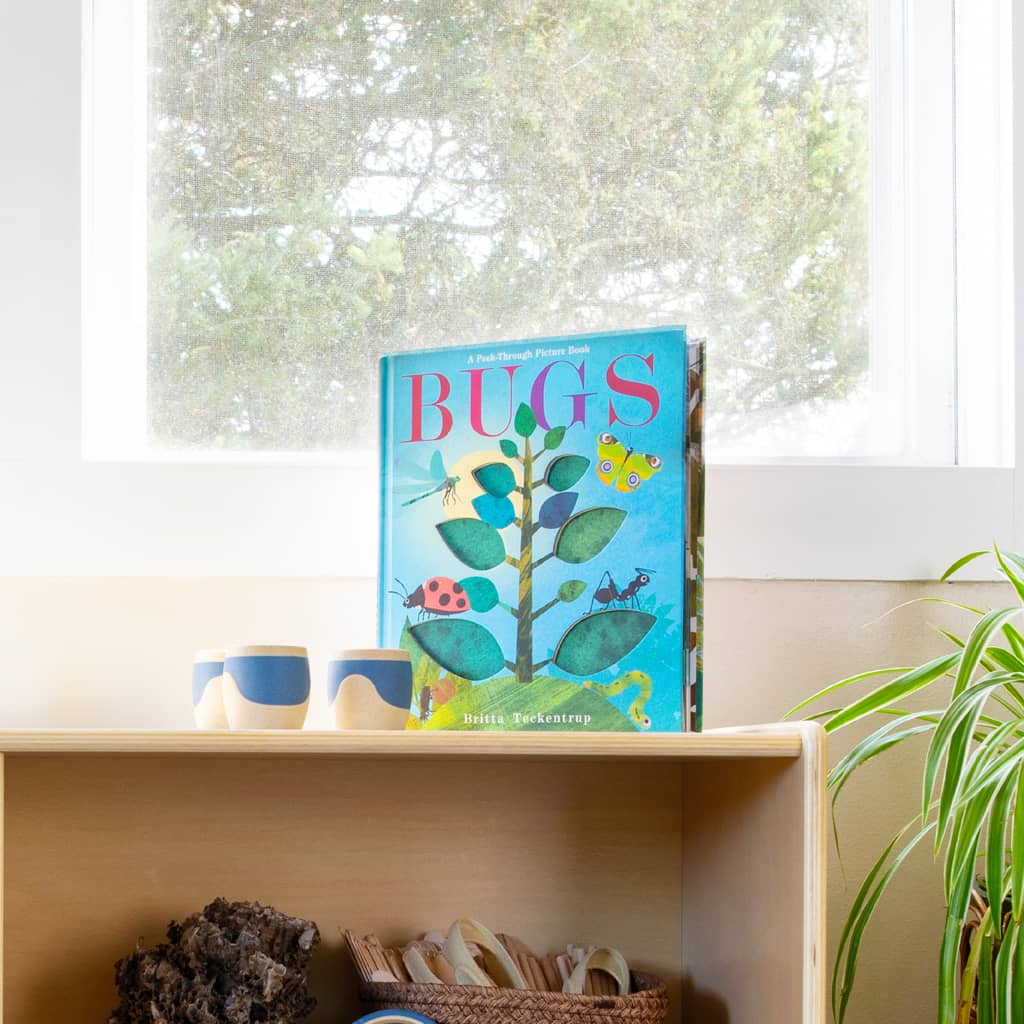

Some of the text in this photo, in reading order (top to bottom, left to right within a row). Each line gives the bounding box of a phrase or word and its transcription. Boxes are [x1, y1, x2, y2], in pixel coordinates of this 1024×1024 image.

[467, 355, 474, 364] A
[535, 347, 565, 358] Picture
[568, 344, 590, 354] Book
[400, 353, 660, 443] BUGS
[464, 713, 504, 724] Britta
